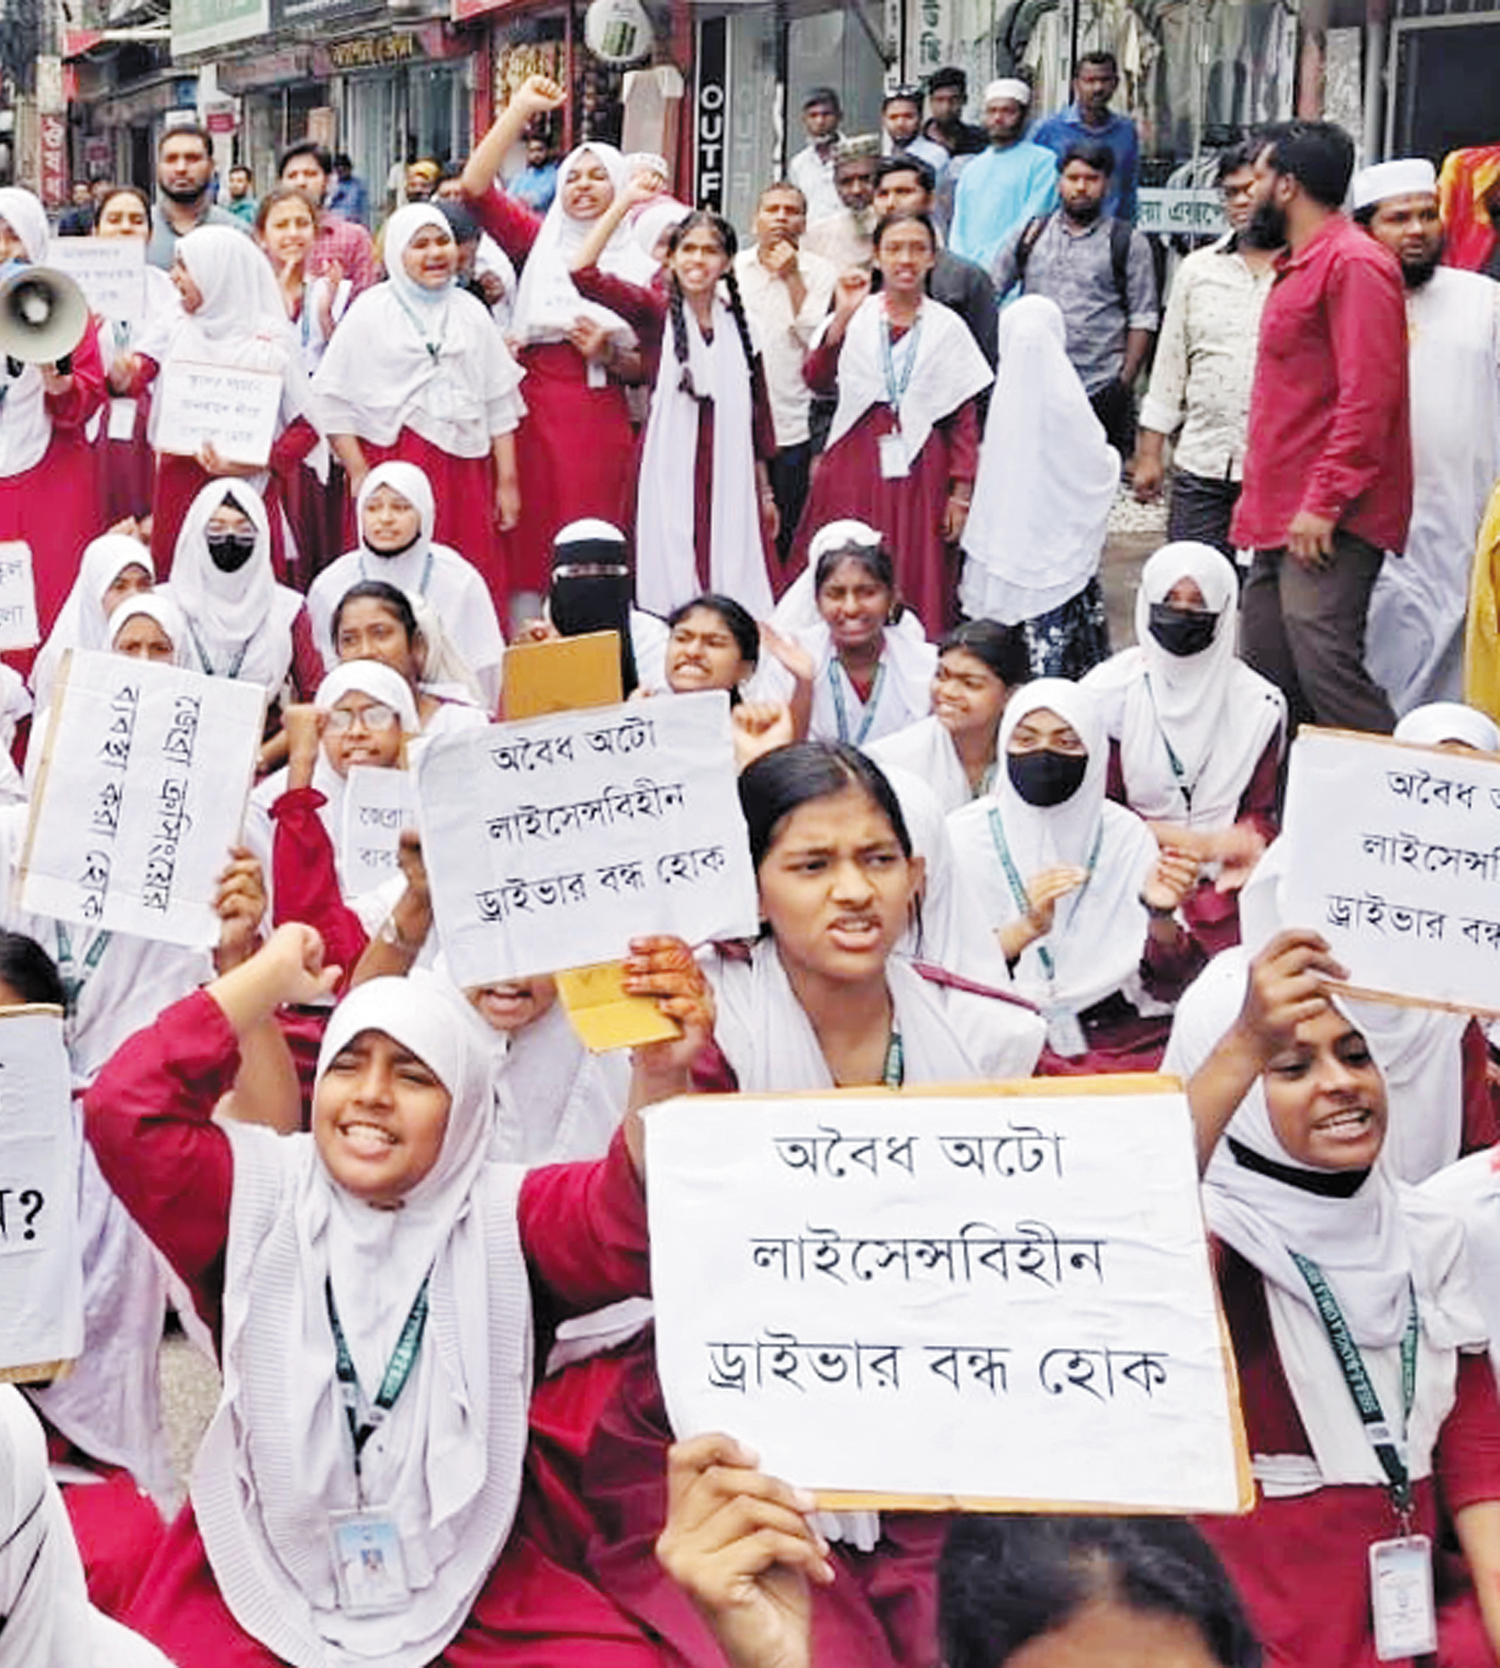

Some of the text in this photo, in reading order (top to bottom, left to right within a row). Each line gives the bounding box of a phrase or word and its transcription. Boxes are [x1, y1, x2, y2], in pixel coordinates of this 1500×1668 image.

[162, 696, 203, 767] জেব্রা
[489, 716, 656, 772] অবৈধ অটো
[78, 685, 140, 922] ব্যবস্থা করা হোক
[485, 776, 685, 844] লাইসেন্সবিহীন
[1386, 768, 1479, 811] অবৈধ
[474, 845, 726, 922] ড্রাইভার বন্ধ হোক
[1327, 890, 1448, 940] ড্রাইভার
[772, 1122, 1067, 1179] অবৈধ অটো
[748, 1220, 1110, 1288] লাইসেন্সবিহীন
[705, 1328, 1170, 1403] ড্রাইভার বন্ধ হোক
